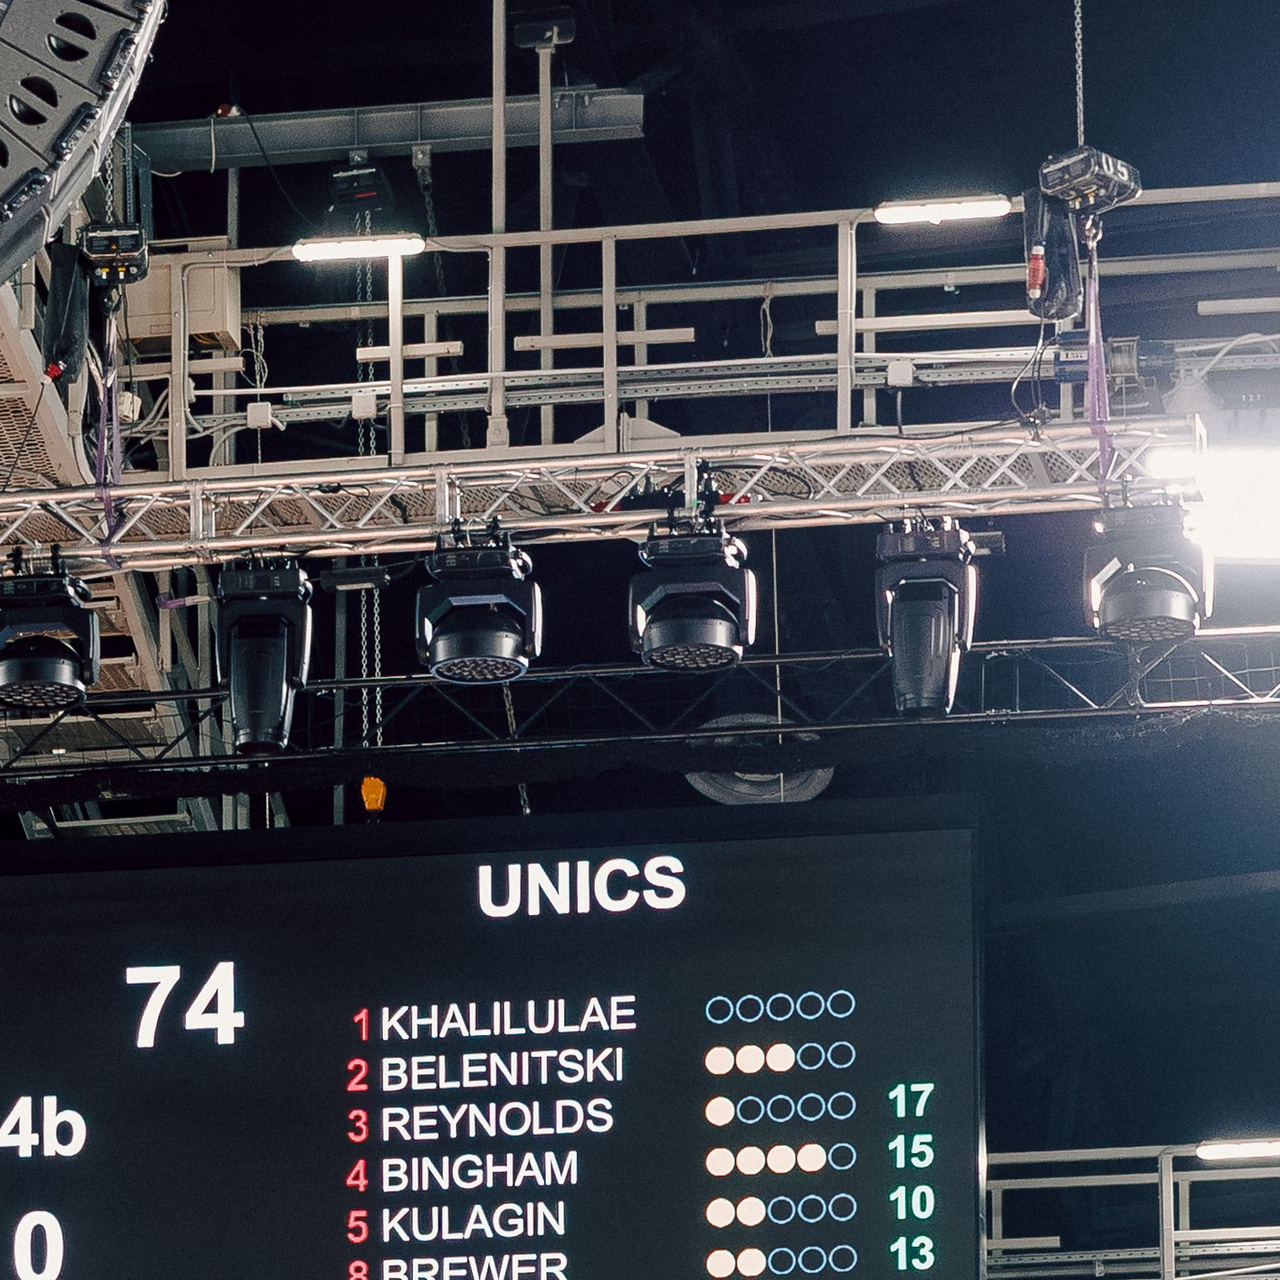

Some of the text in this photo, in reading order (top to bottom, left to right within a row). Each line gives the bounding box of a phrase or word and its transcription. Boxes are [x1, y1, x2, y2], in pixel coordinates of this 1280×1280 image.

[478, 855, 686, 918] UNICS
[125, 961, 245, 1049] 74
[353, 994, 637, 1041] 1 KHALILULAE
[346, 1046, 623, 1092] 2 BELENITSKI
[346, 1097, 614, 1143] 3 REYNOLDS
[888, 1082, 935, 1118] 17
[345, 1150, 578, 1193] 4 BINGHAM
[888, 1133, 935, 1169] 15
[346, 1200, 566, 1244] 5 KULAGIN
[889, 1184, 935, 1220] 10
[889, 1235, 935, 1271] 13
